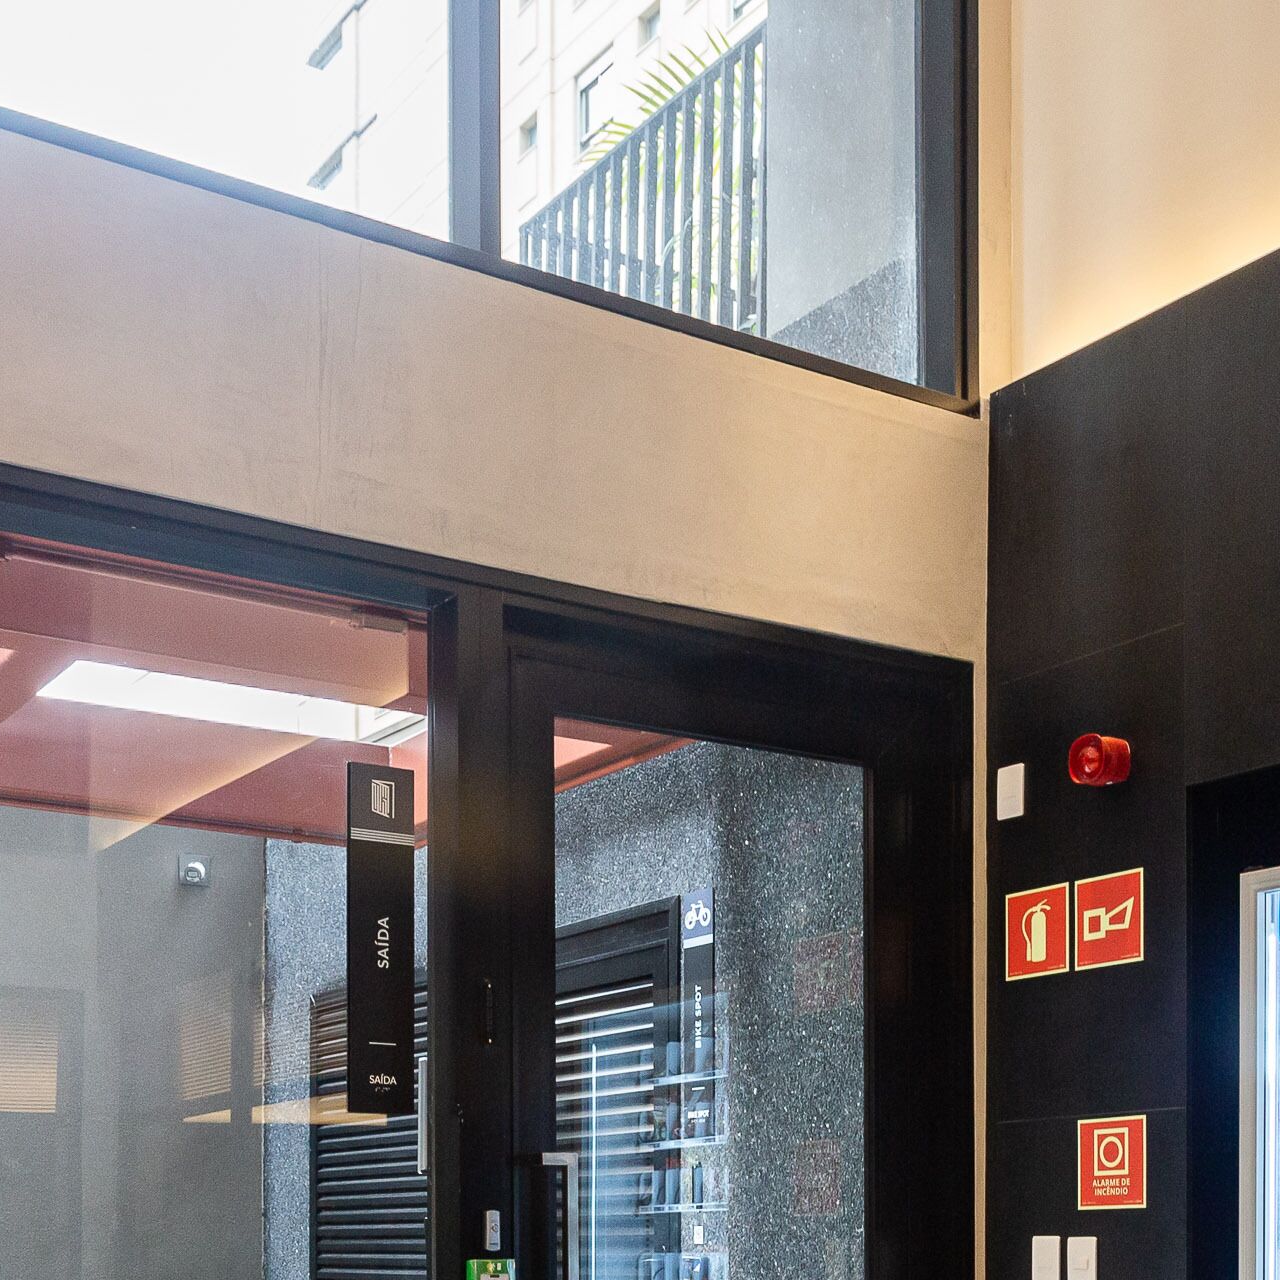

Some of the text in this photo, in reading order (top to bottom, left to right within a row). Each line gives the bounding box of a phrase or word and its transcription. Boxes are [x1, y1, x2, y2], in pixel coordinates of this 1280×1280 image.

[375, 916, 389, 969] SAÍDA
[369, 1072, 397, 1086] SAÍDA
[1093, 1177, 1131, 1187] ALARME DE
[1094, 1187, 1129, 1196] INCÊNDIO
